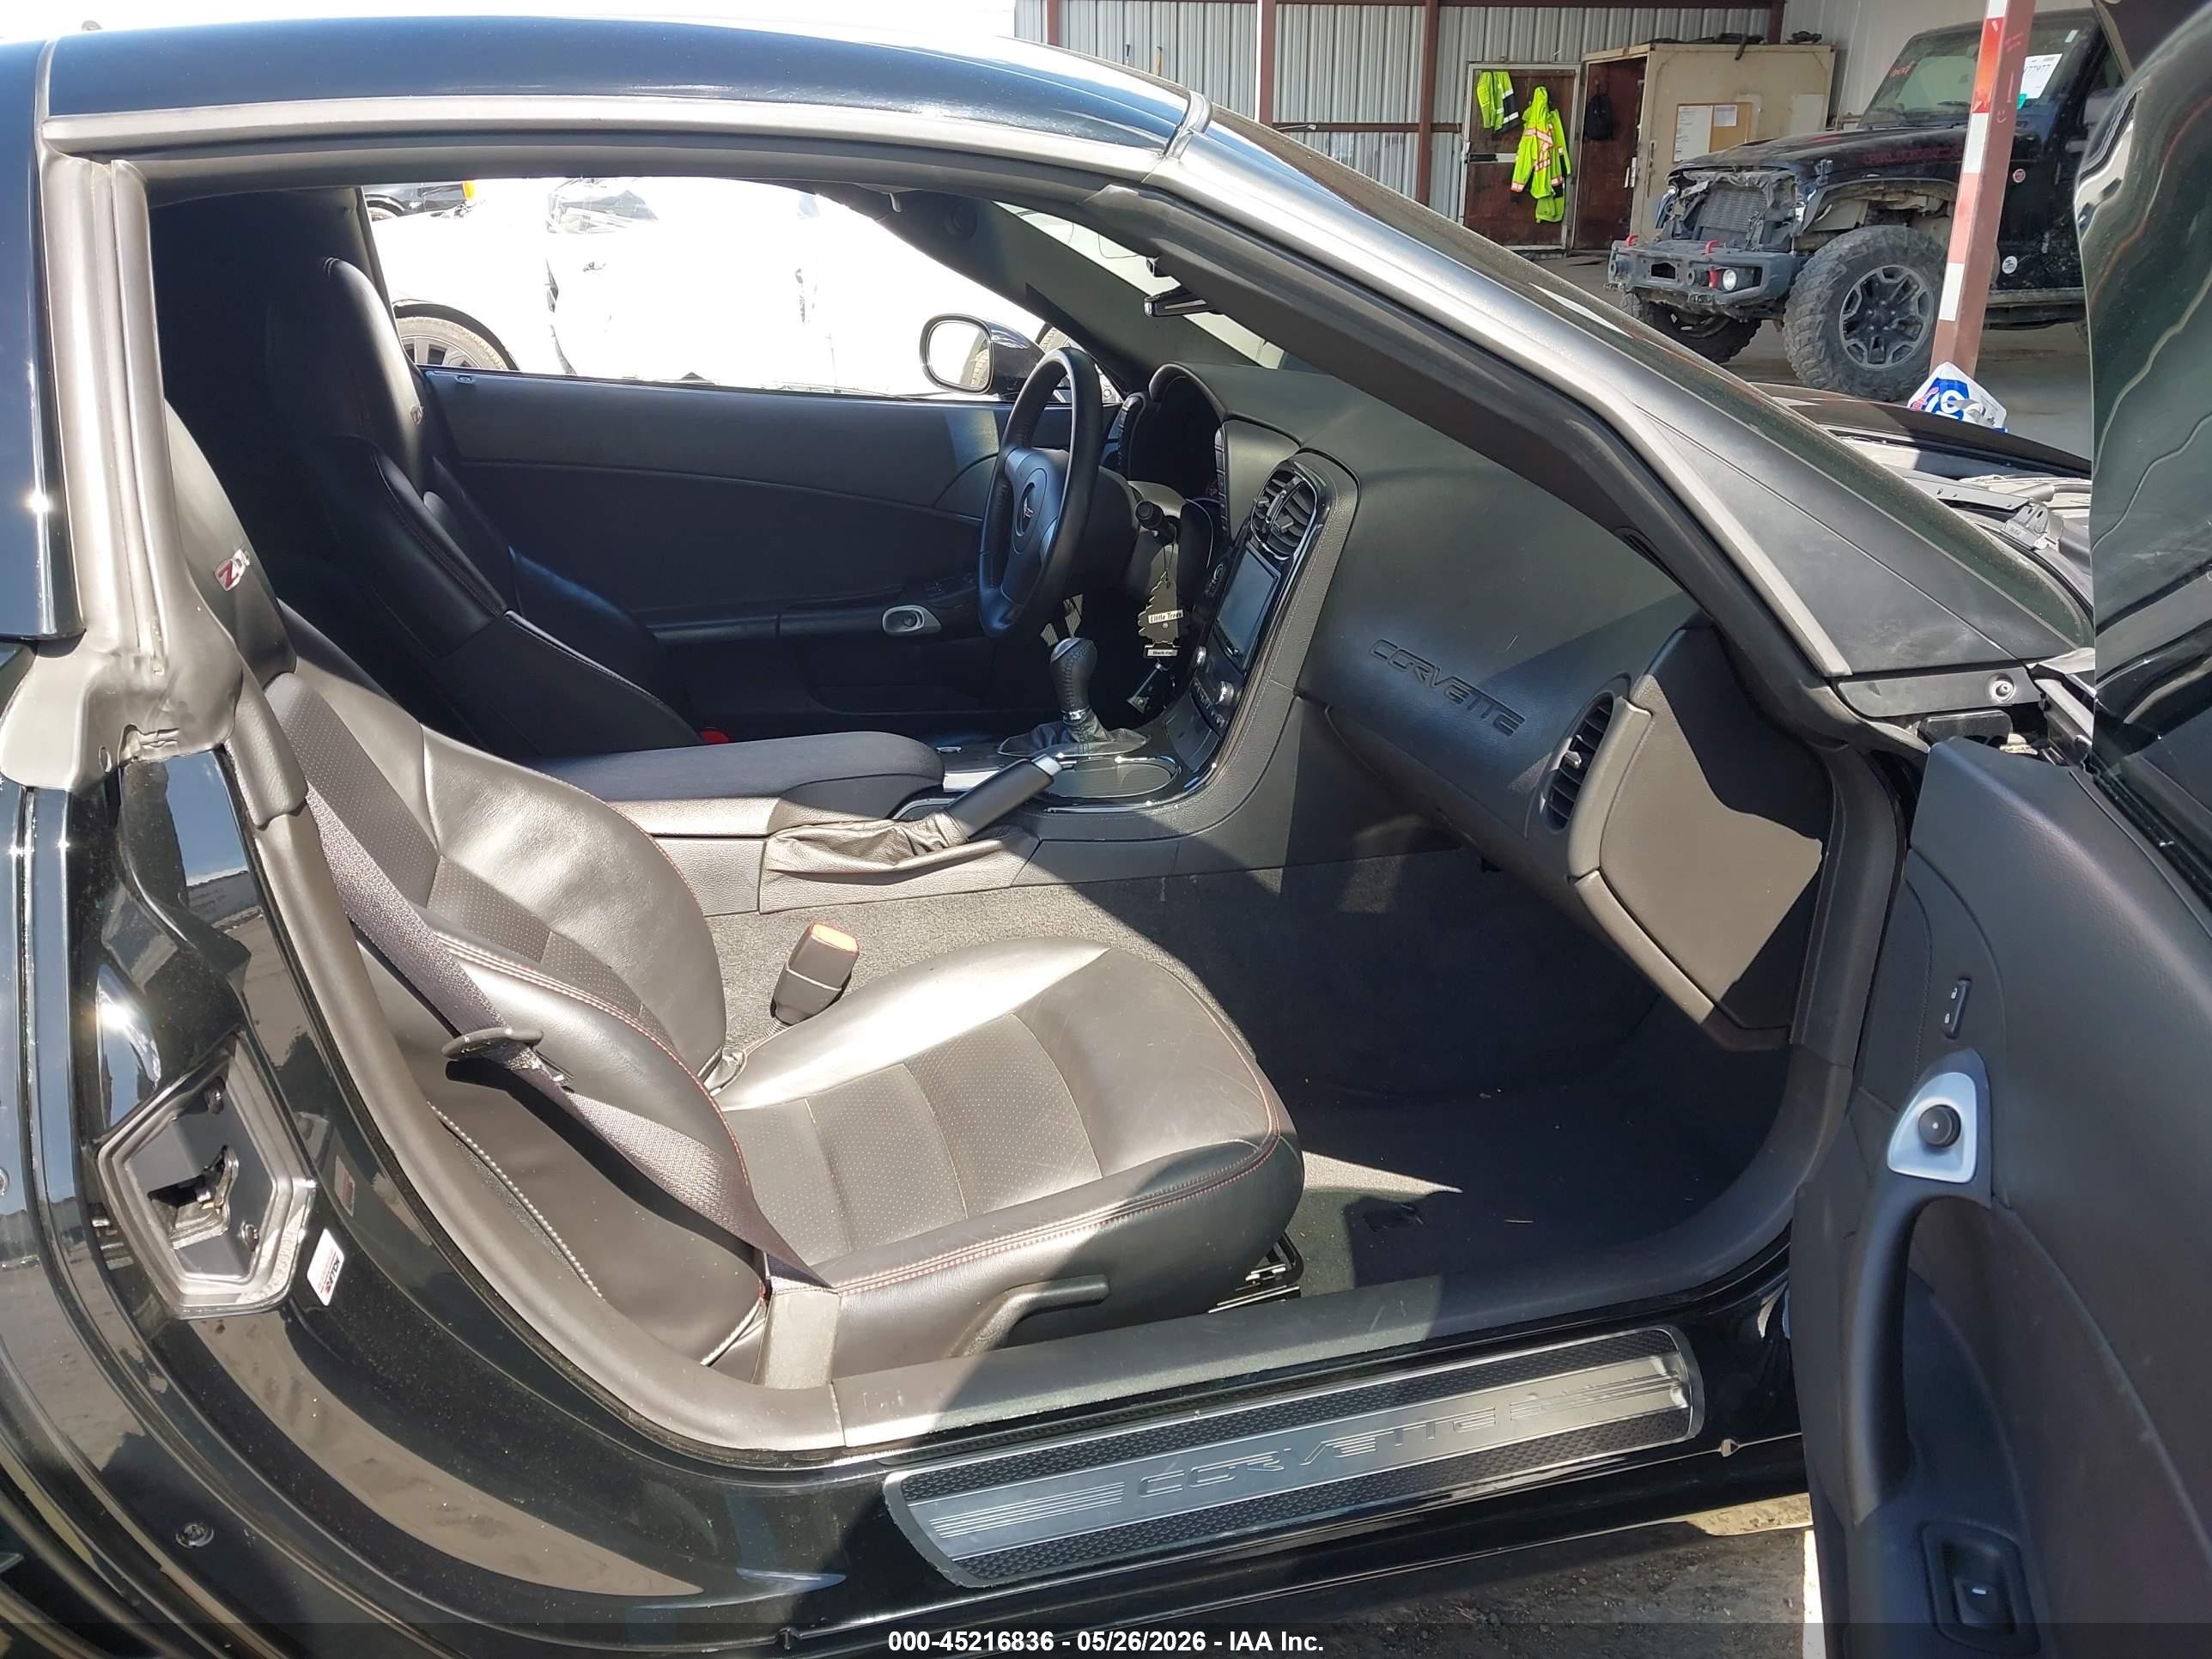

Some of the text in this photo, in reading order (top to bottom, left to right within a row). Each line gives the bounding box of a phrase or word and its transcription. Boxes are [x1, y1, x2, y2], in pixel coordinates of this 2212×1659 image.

[1151, 613, 1166, 623] Little
[1369, 638, 1526, 737] CORVETTE
[1139, 1407, 1497, 1498] CORVETTE
